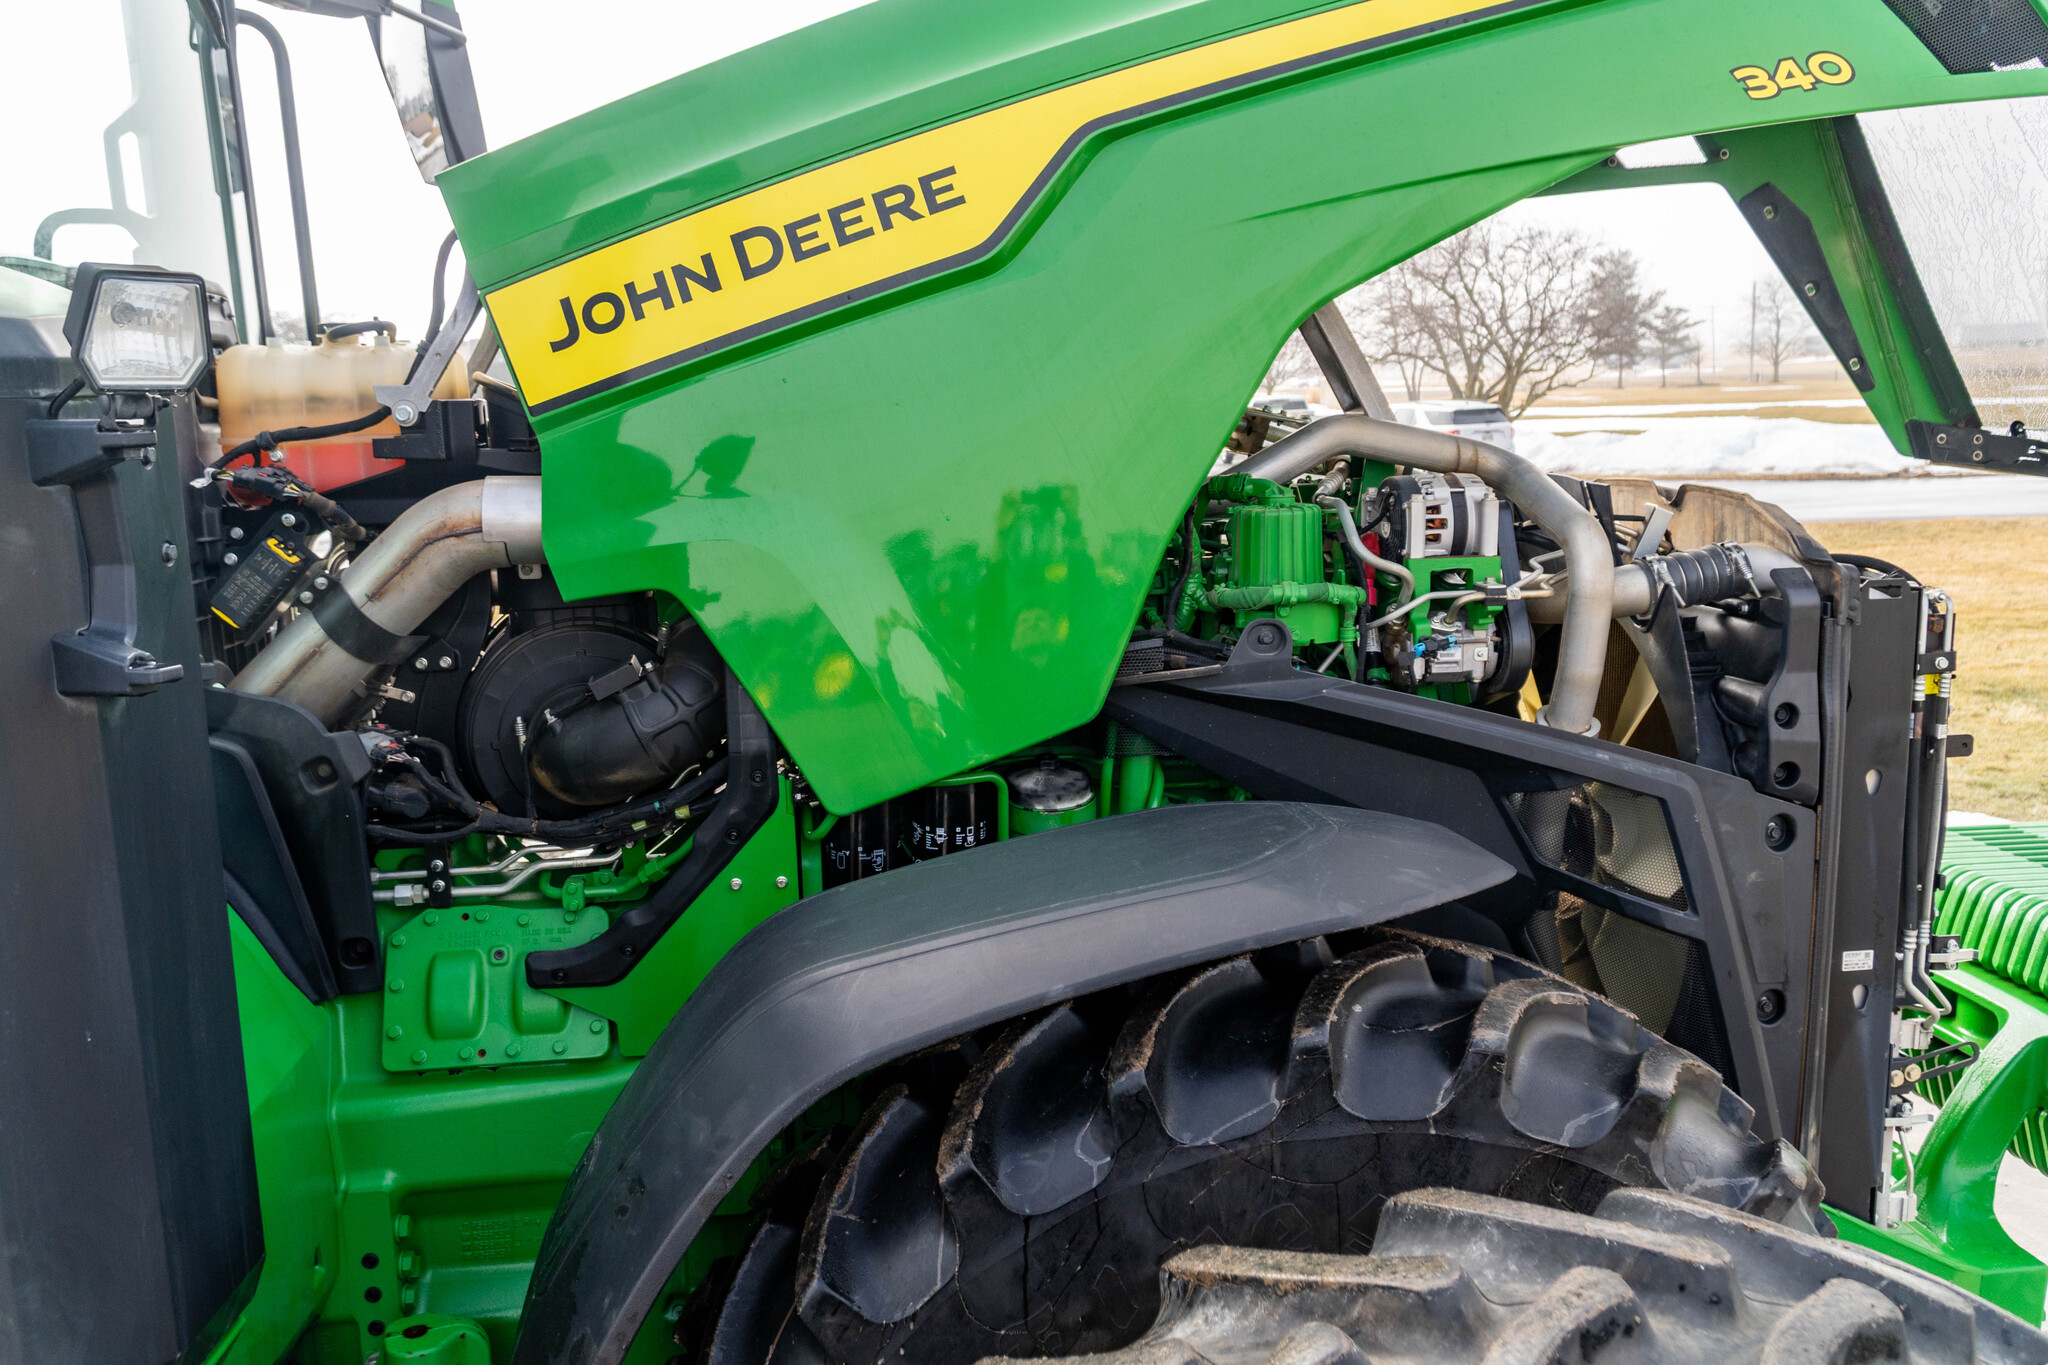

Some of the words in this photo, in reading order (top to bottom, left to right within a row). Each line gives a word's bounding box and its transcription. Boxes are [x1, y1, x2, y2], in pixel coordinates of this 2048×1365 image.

[1729, 50, 1856, 100] 340
[549, 252, 723, 353] JOHN
[729, 165, 966, 281] DEERE
